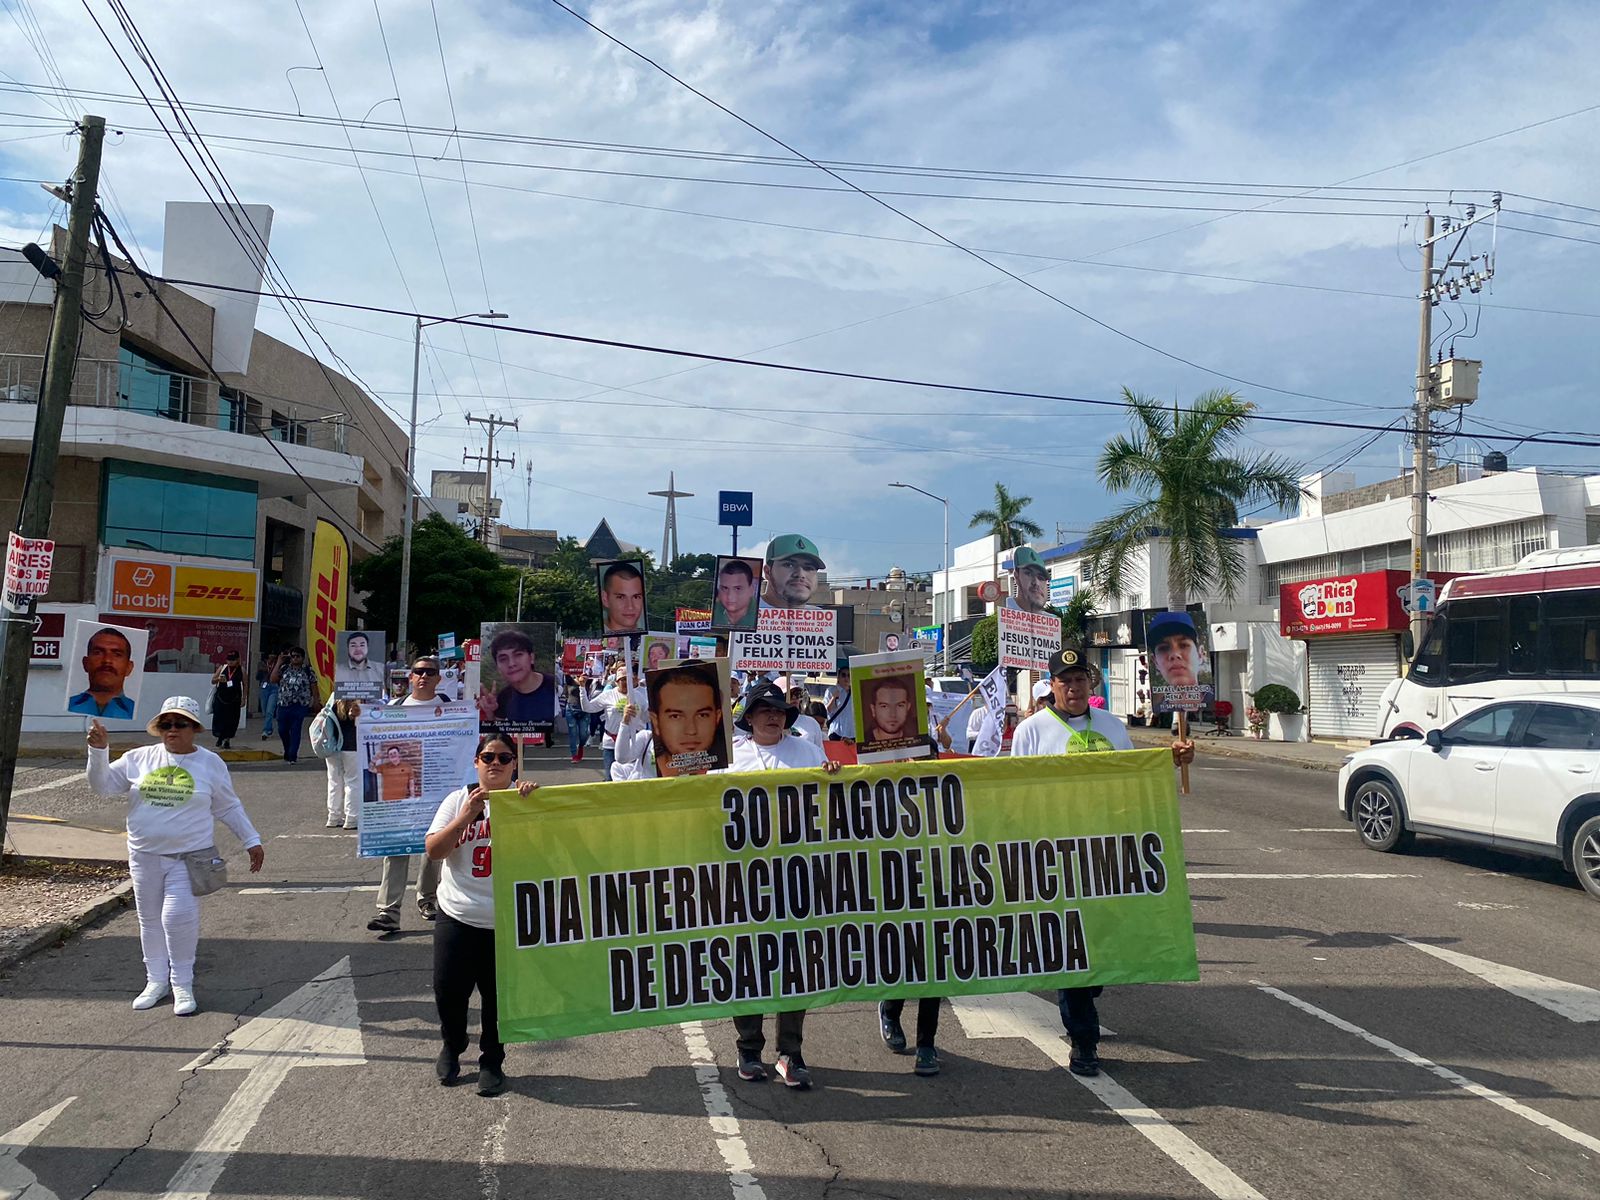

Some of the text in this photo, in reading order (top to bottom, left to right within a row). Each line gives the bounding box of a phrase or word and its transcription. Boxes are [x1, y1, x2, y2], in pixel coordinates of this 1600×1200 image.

[722, 503, 749, 511] BBVA
[10, 535, 54, 552] COMPRO
[9, 550, 51, 568] AIRES
[36, 569, 50, 580] DE
[114, 590, 168, 608] inabit
[186, 585, 245, 601] DHL
[1324, 583, 1353, 599] Rica
[757, 608, 833, 621] SAPARECIDO
[1001, 608, 1059, 627] DESAPARECIDO
[315, 567, 340, 690] DHL
[735, 634, 834, 646] JESUS TOMAS
[1001, 632, 1061, 651] JESUS TOMAS
[33, 643, 56, 656] bit
[743, 647, 828, 659] FELIX FELIX
[1006, 645, 1031, 658] FELIX
[736, 660, 833, 670] ¡ESPERAMOS TU REGRESO!
[438, 729, 474, 737] RODRIGUEZ
[722, 774, 965, 852] 30 DE AGOSTO
[514, 832, 1168, 949] DIA INTERNACIONAL DE LAS VICTIMAS
[609, 908, 1090, 1015] DE DESAPARICION FORZADA
